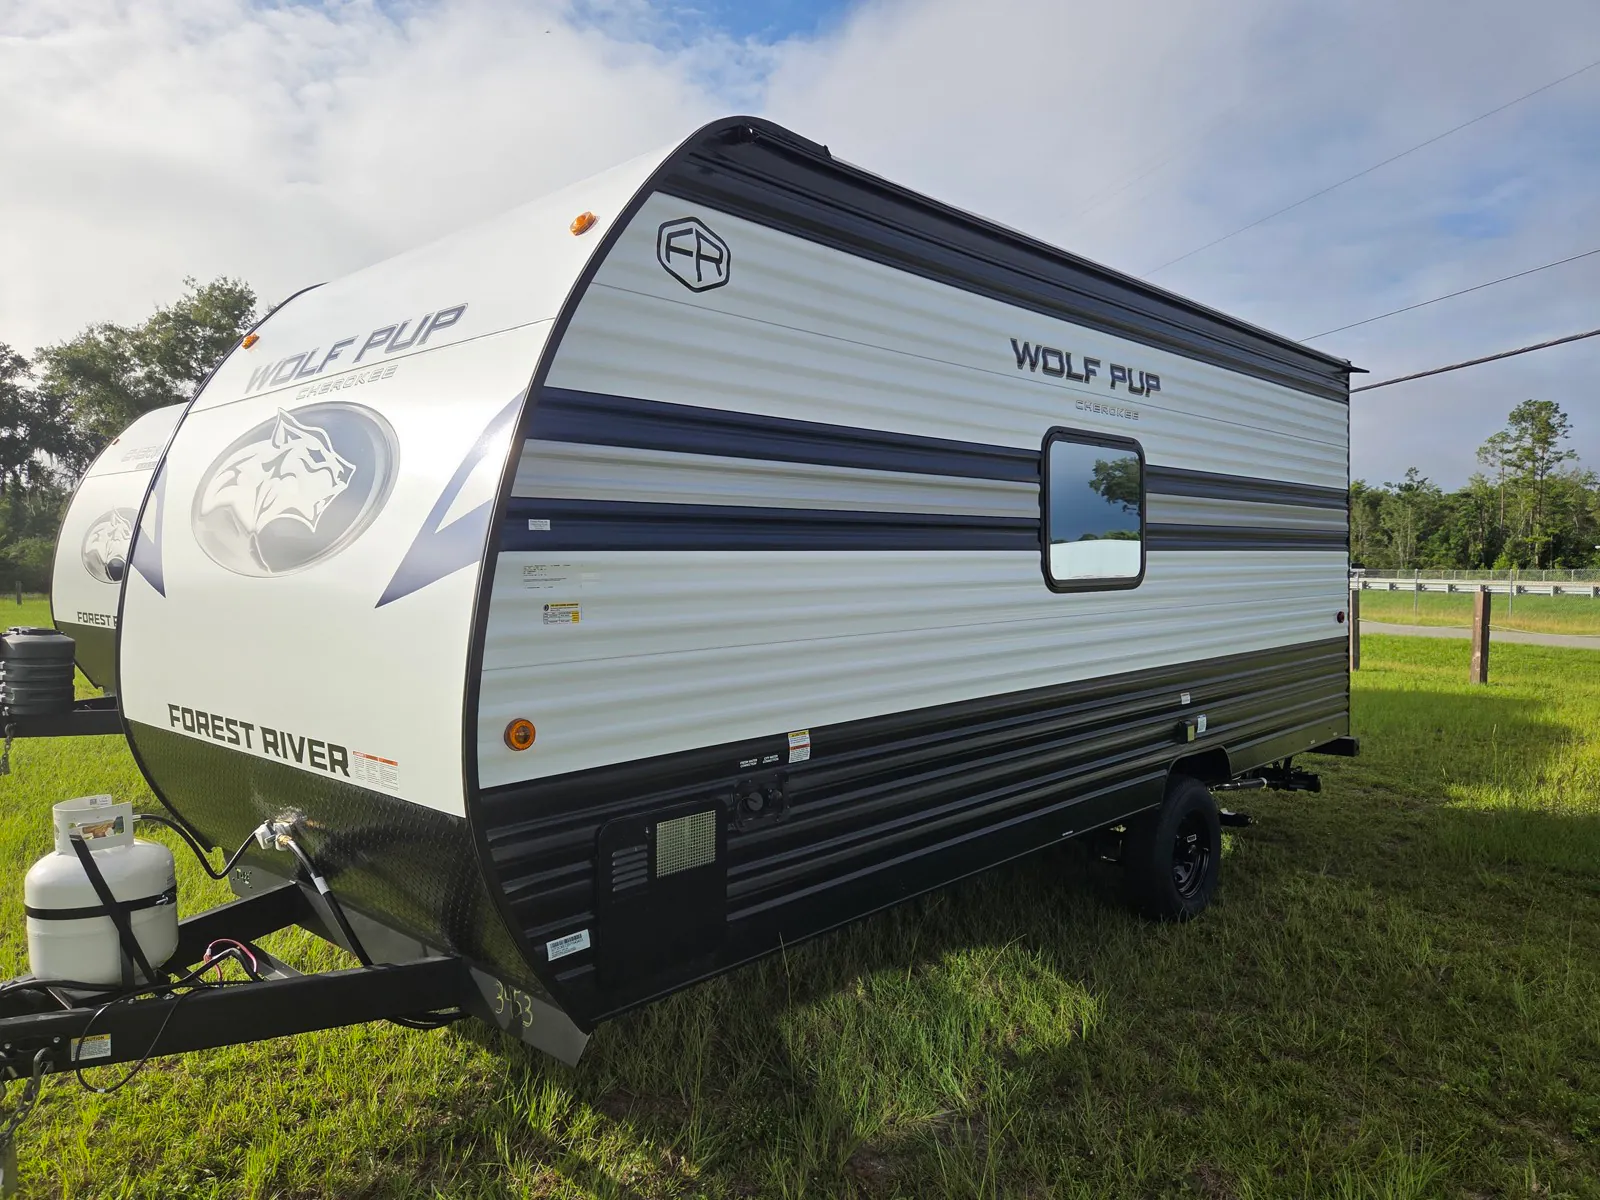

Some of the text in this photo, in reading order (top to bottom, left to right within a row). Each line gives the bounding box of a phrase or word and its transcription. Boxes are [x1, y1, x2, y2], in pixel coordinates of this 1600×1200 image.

[244, 302, 468, 394] WOLF PUP
[1010, 338, 1161, 397] WOLF PUP
[296, 364, 398, 400] CHEROKEE
[1075, 400, 1139, 420] CHEROKEE
[77, 611, 111, 626] FOREST
[168, 703, 254, 749] FOREST
[260, 726, 350, 778] RIVER
